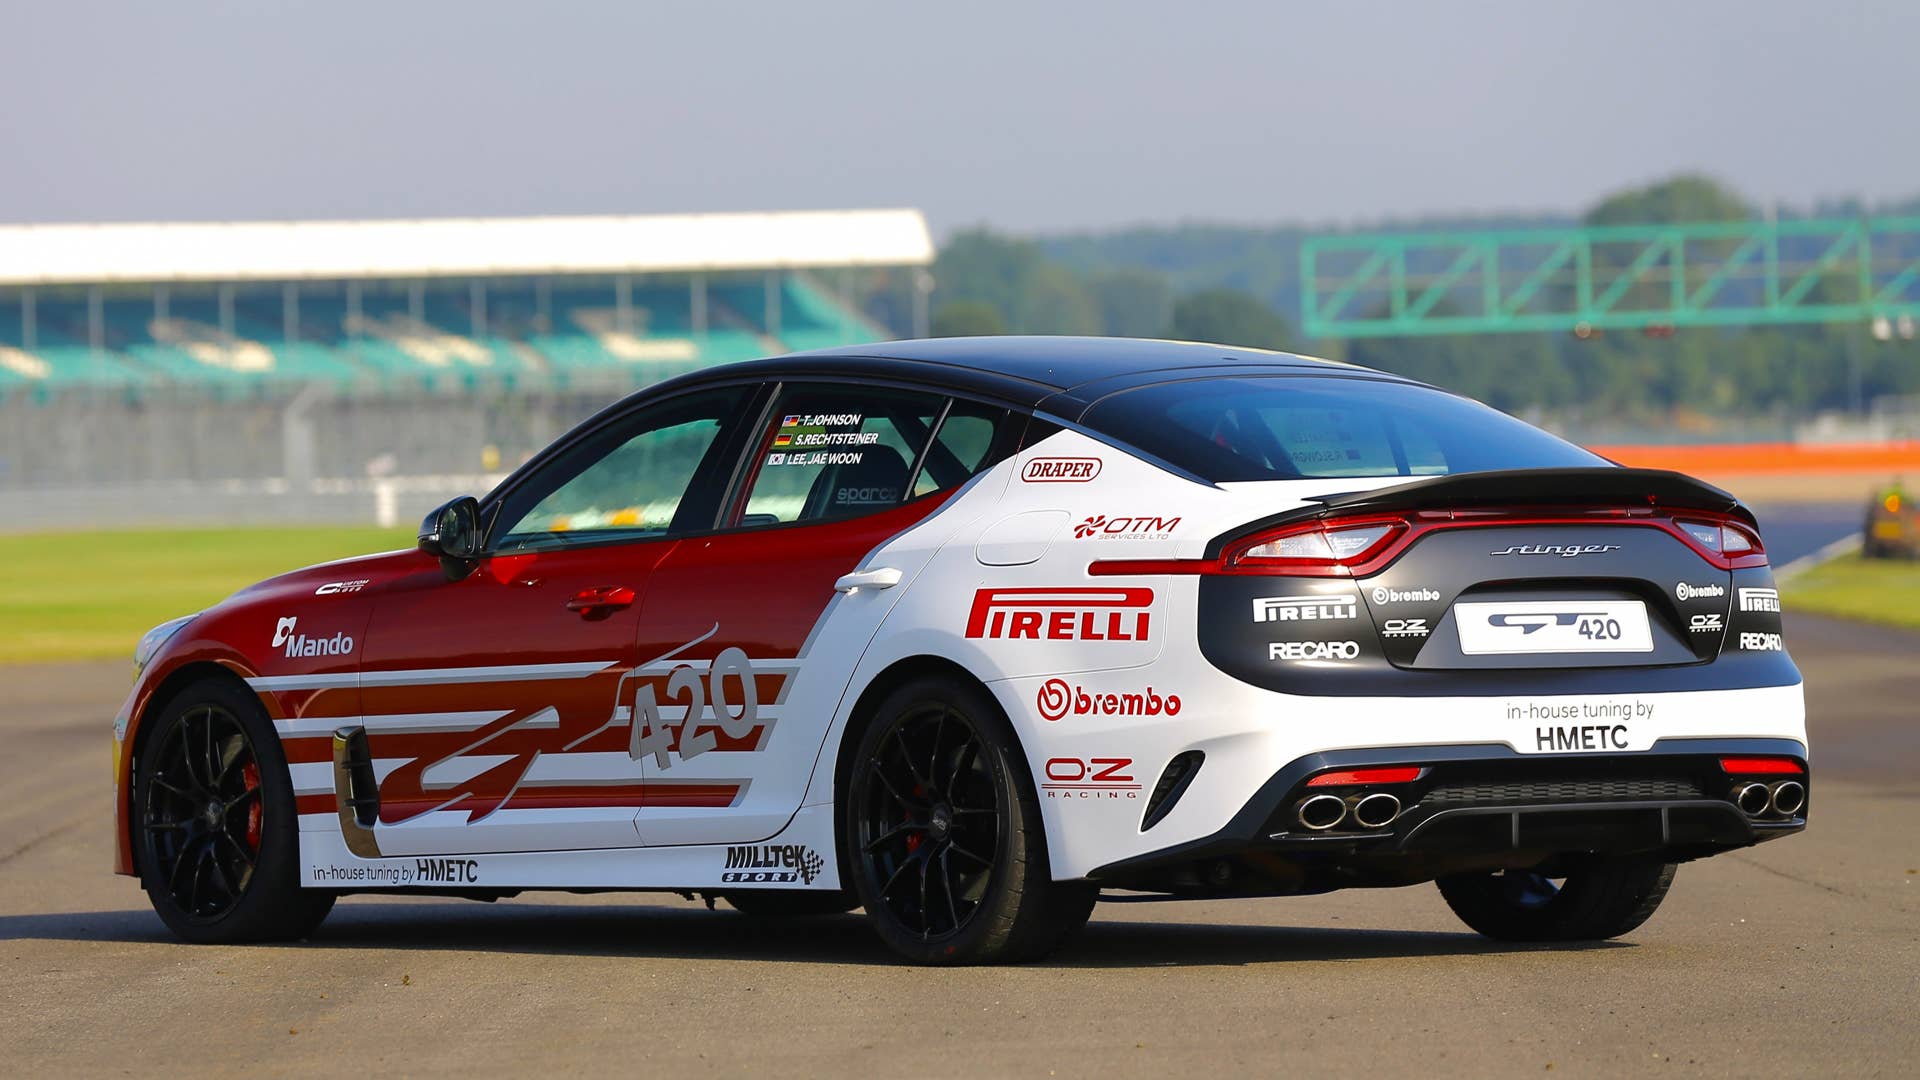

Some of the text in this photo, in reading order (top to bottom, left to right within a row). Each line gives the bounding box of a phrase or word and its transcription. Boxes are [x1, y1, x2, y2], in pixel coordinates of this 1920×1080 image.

[802, 414, 861, 426] T.JOHNSON
[795, 433, 879, 445] S.RECHTSTEINER
[829, 453, 863, 465] WOON
[1028, 462, 1094, 478] DRAPER
[1103, 517, 1182, 533] OTM
[1390, 588, 1441, 602] brembo
[1688, 584, 1724, 597] brembo
[965, 587, 1154, 641] PIRELLI
[1253, 595, 1357, 623] PIRELLI
[1578, 619, 1622, 640] 420
[285, 632, 354, 658] Mando
[1269, 641, 1360, 660] RECARO
[1739, 632, 1782, 651] RECARO
[628, 647, 758, 771] 420
[1074, 686, 1182, 716] brembo
[1507, 700, 1655, 721] in-house tuning by
[1536, 724, 1629, 751] HMETC
[1047, 791, 1137, 799] RACING
[313, 859, 478, 884] in-house tuning by HMETC
[725, 873, 796, 882] SPORT
